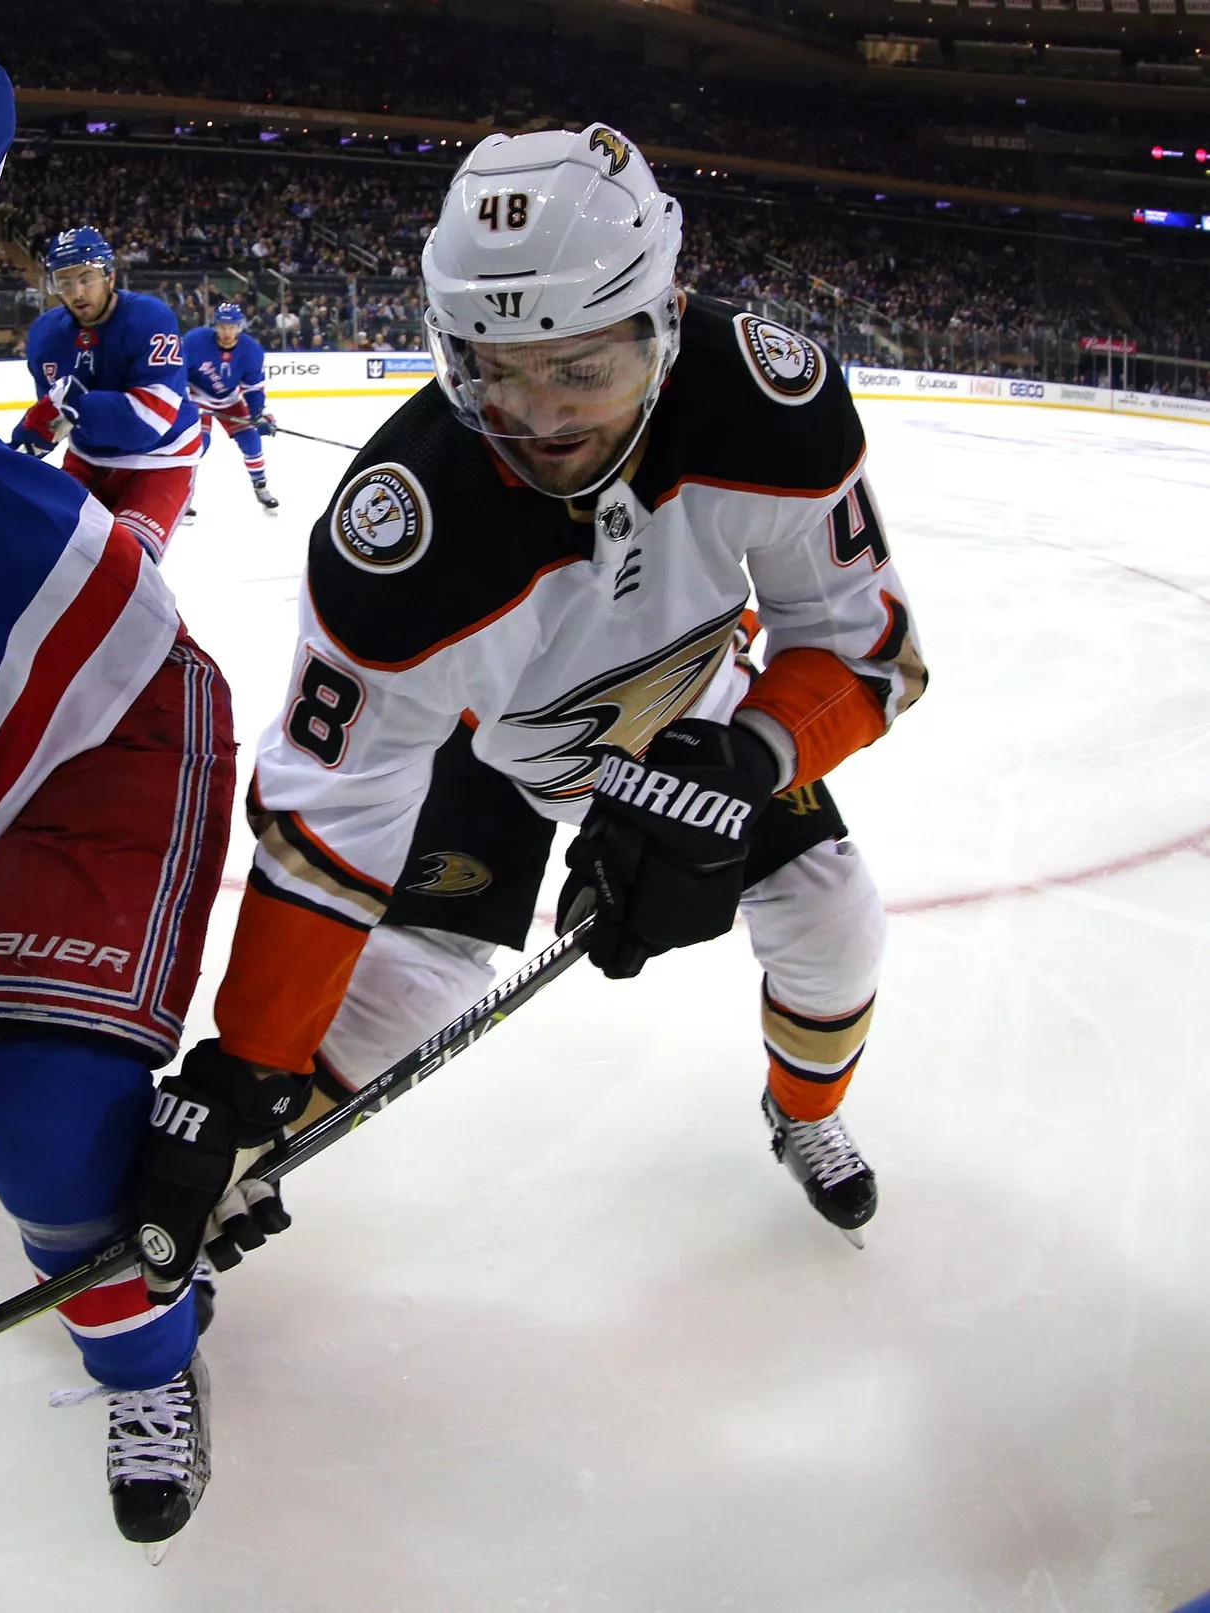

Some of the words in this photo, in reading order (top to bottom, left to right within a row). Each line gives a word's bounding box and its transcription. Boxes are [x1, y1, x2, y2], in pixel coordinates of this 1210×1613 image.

[478, 193, 530, 233] 48
[148, 333, 184, 366] 22
[858, 371, 898, 387] Spectrum
[1010, 382, 1045, 398] GEICO
[370, 474, 416, 536] ANAHEIM
[663, 730, 701, 746] SHAW
[593, 753, 752, 841] ARRIOR
[272, 1096, 290, 1115] 48
